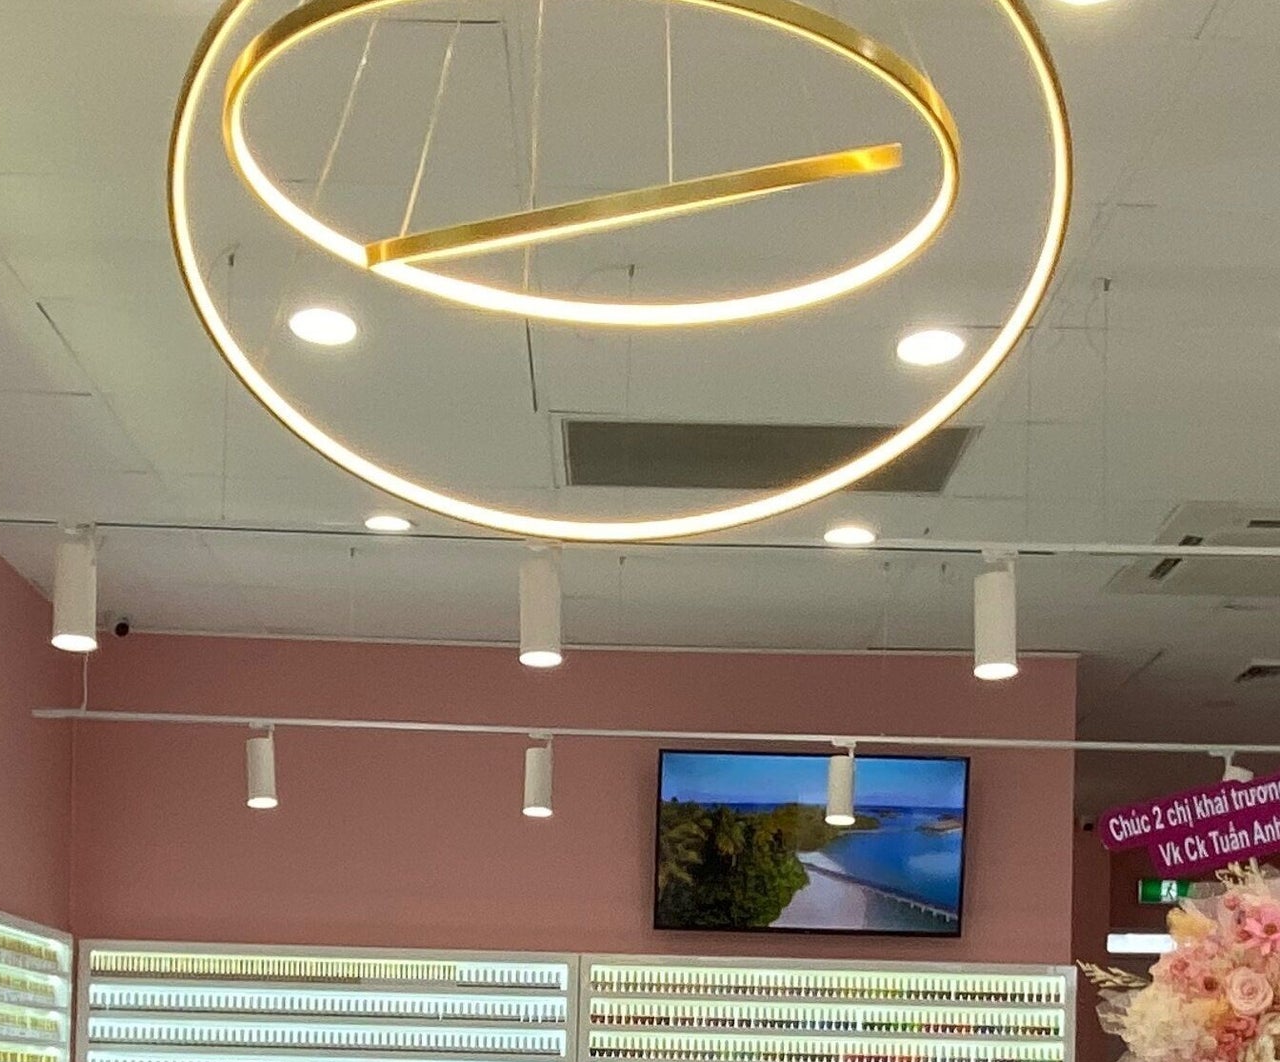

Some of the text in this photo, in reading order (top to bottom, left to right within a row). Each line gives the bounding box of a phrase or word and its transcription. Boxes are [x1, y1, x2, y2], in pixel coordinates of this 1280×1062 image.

[1109, 810, 1151, 841] Chúc
[1152, 806, 1164, 829] 2
[1193, 789, 1229, 820] khai
[1158, 841, 1183, 867] Vk
[1184, 835, 1208, 862] Ck
